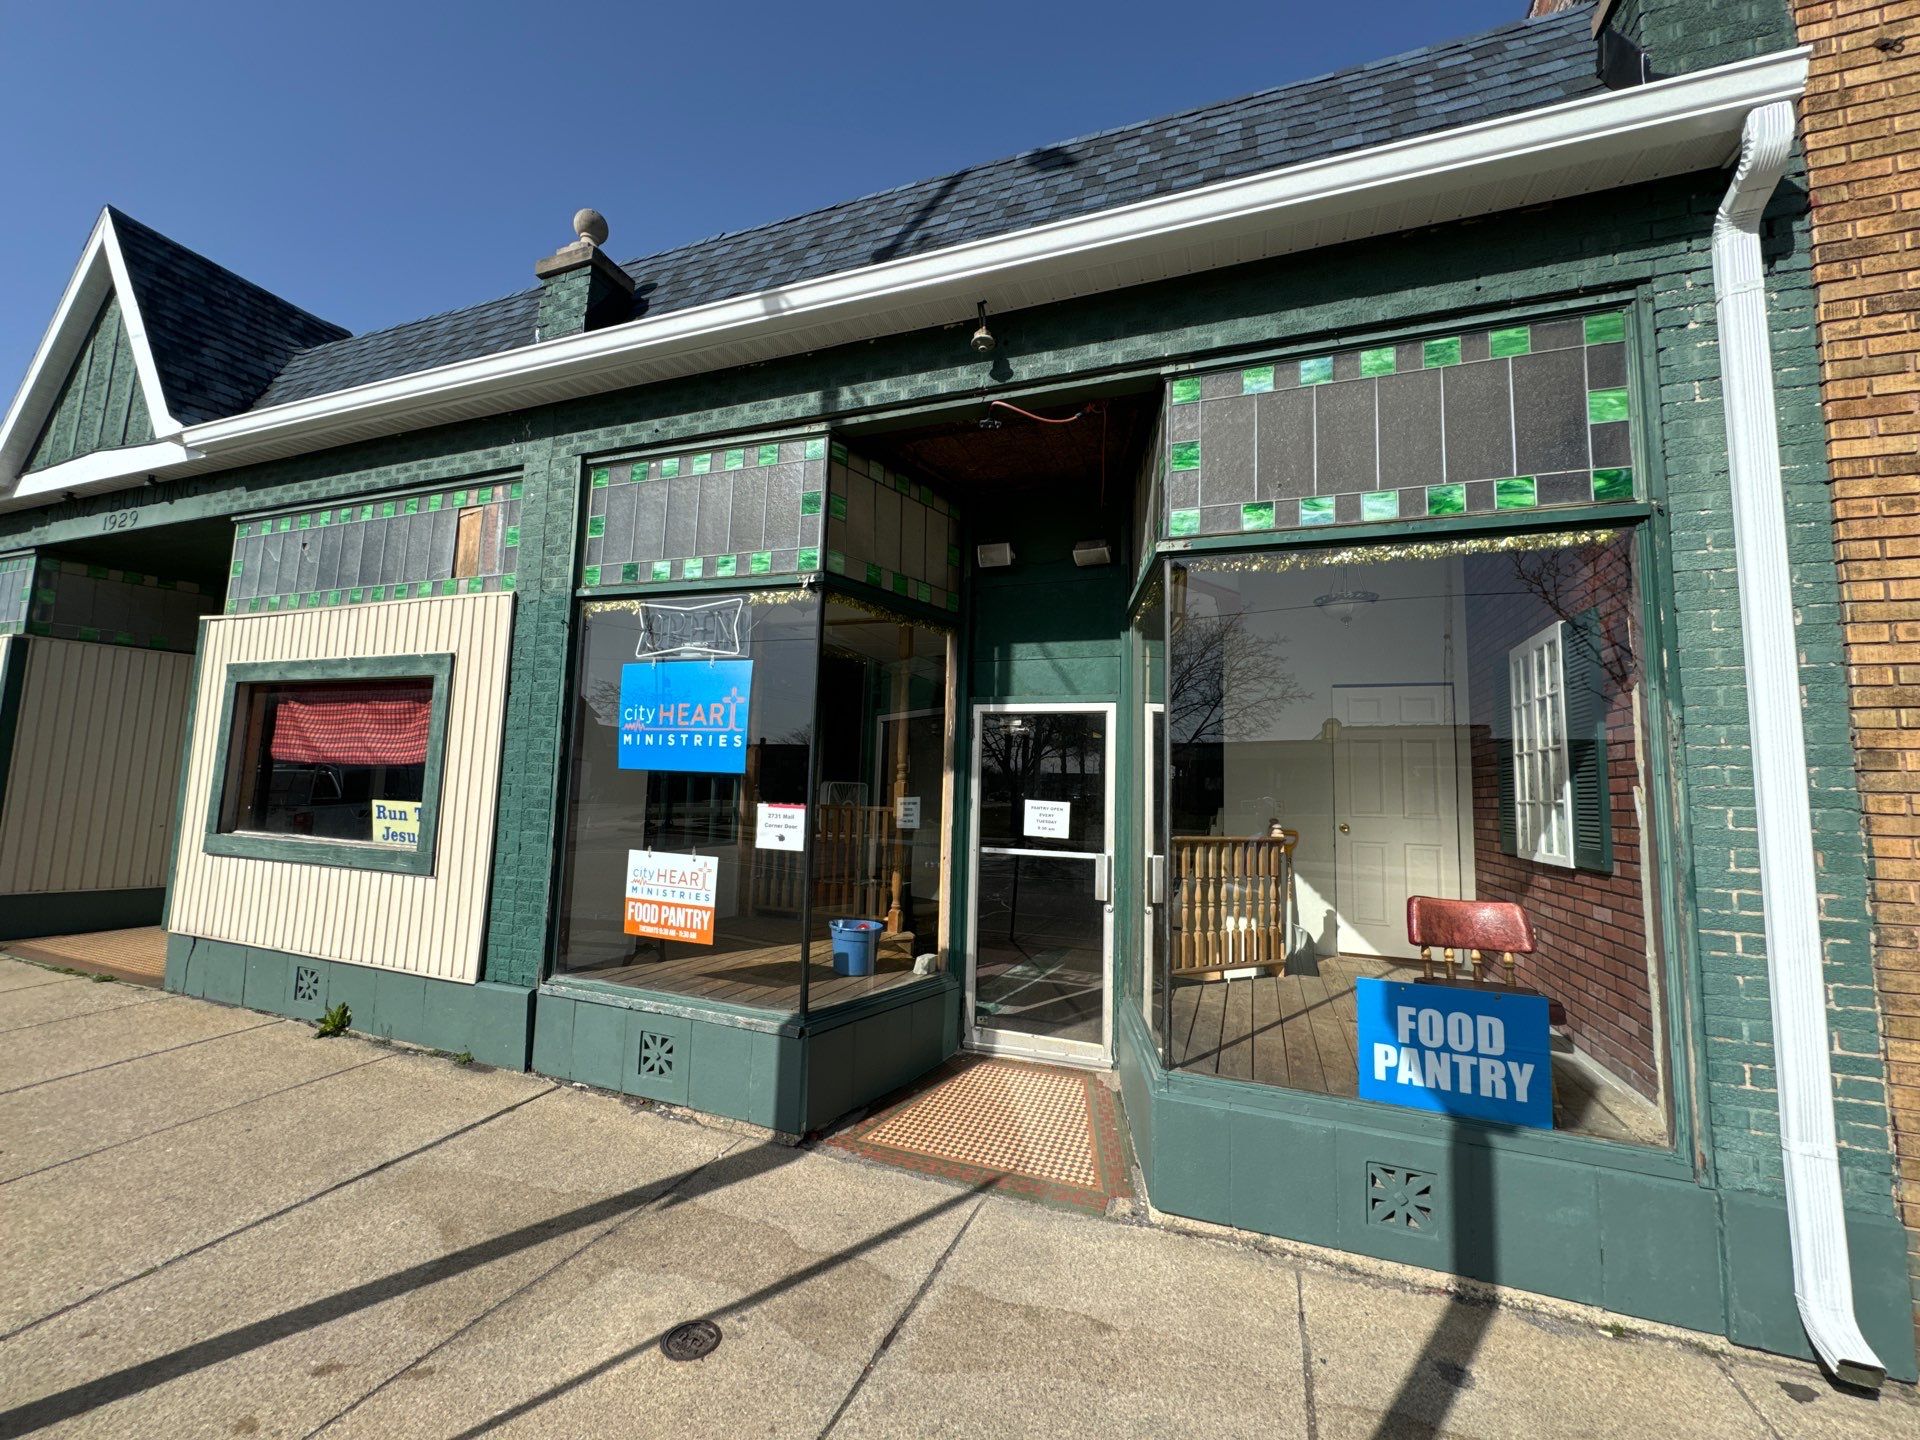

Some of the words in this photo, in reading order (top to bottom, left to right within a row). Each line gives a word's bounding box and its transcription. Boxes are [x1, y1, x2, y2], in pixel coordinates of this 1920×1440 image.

[102, 510, 139, 531] 1929
[624, 704, 656, 724] city
[623, 733, 742, 748] MINISTRIES
[376, 804, 408, 821] Run
[382, 826, 419, 844] Jesu
[633, 866, 655, 881] city
[631, 885, 711, 902] MINISTRIES
[627, 901, 659, 924] FOOD
[660, 905, 711, 931] PANTRY
[1397, 1005, 1506, 1056] FOOD
[1373, 1042, 1536, 1103] PANTRY
